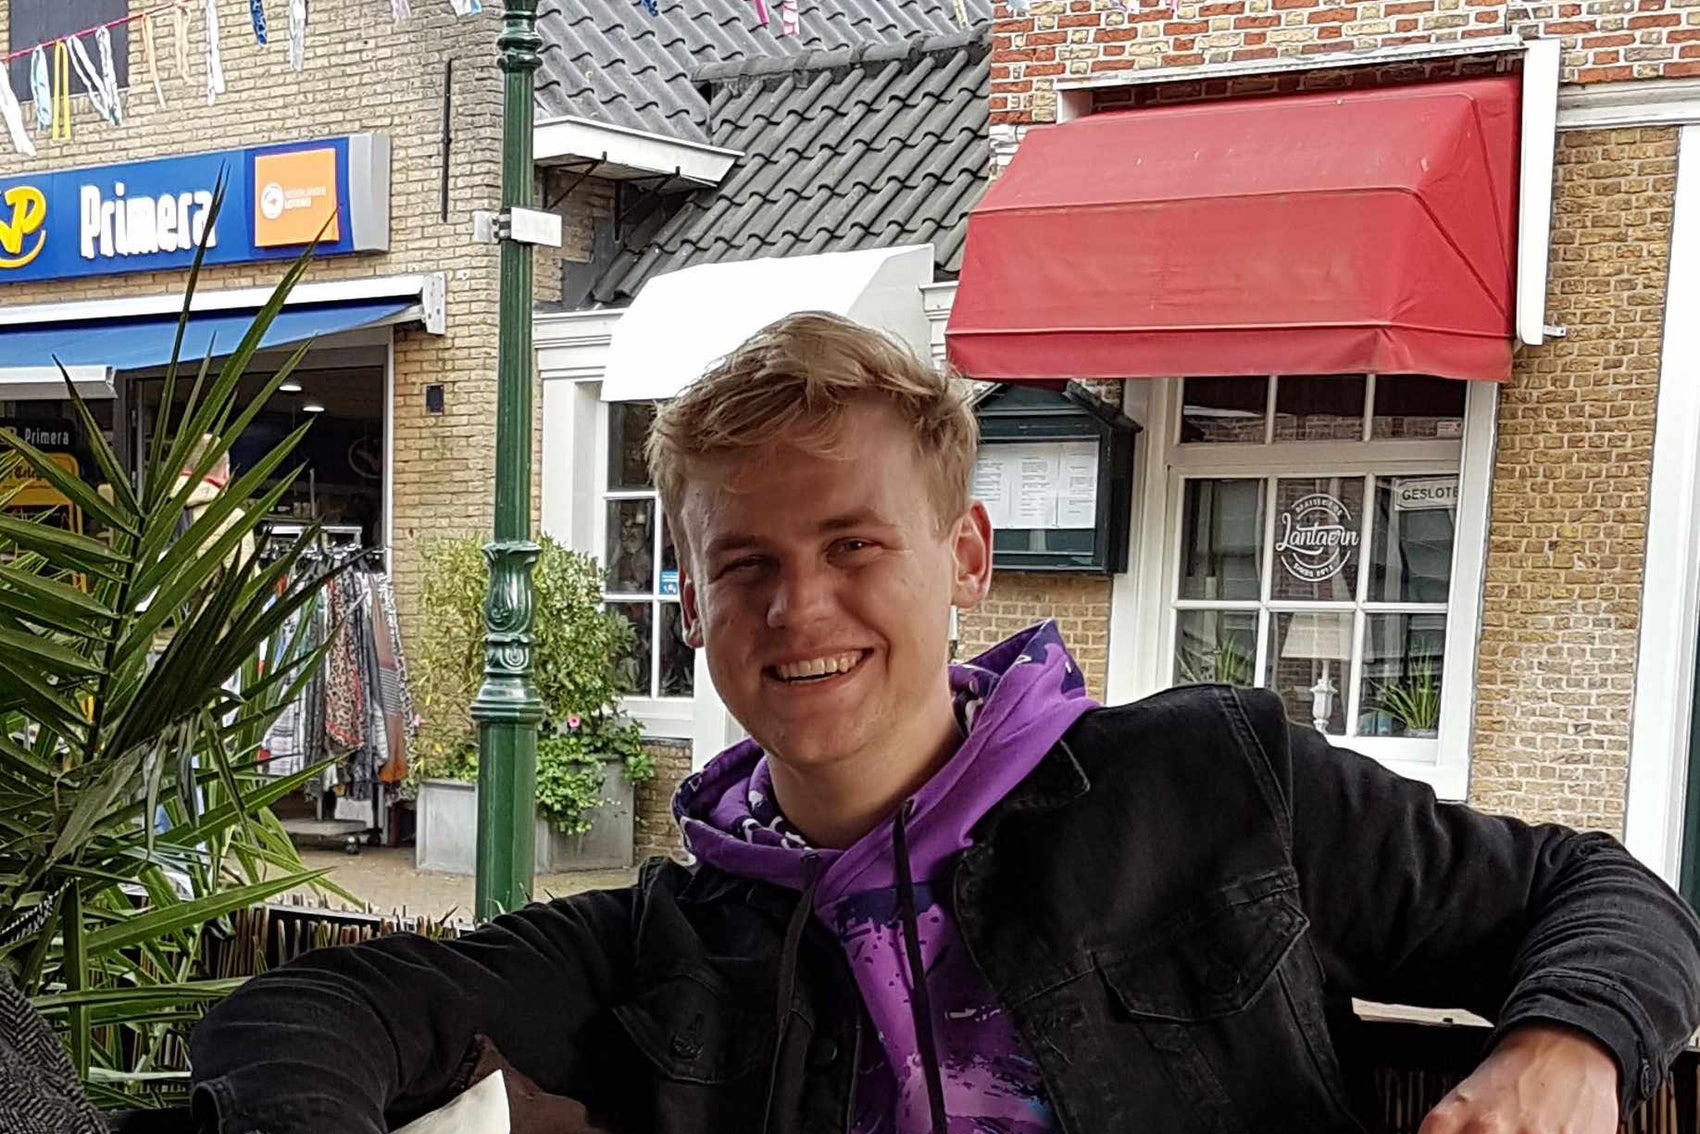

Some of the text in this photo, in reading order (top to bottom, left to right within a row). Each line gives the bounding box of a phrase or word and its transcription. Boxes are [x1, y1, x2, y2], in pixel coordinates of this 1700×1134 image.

[80, 182, 217, 260] Primera
[25, 428, 69, 445] Primera
[1402, 486, 1459, 500] GESLOTE
